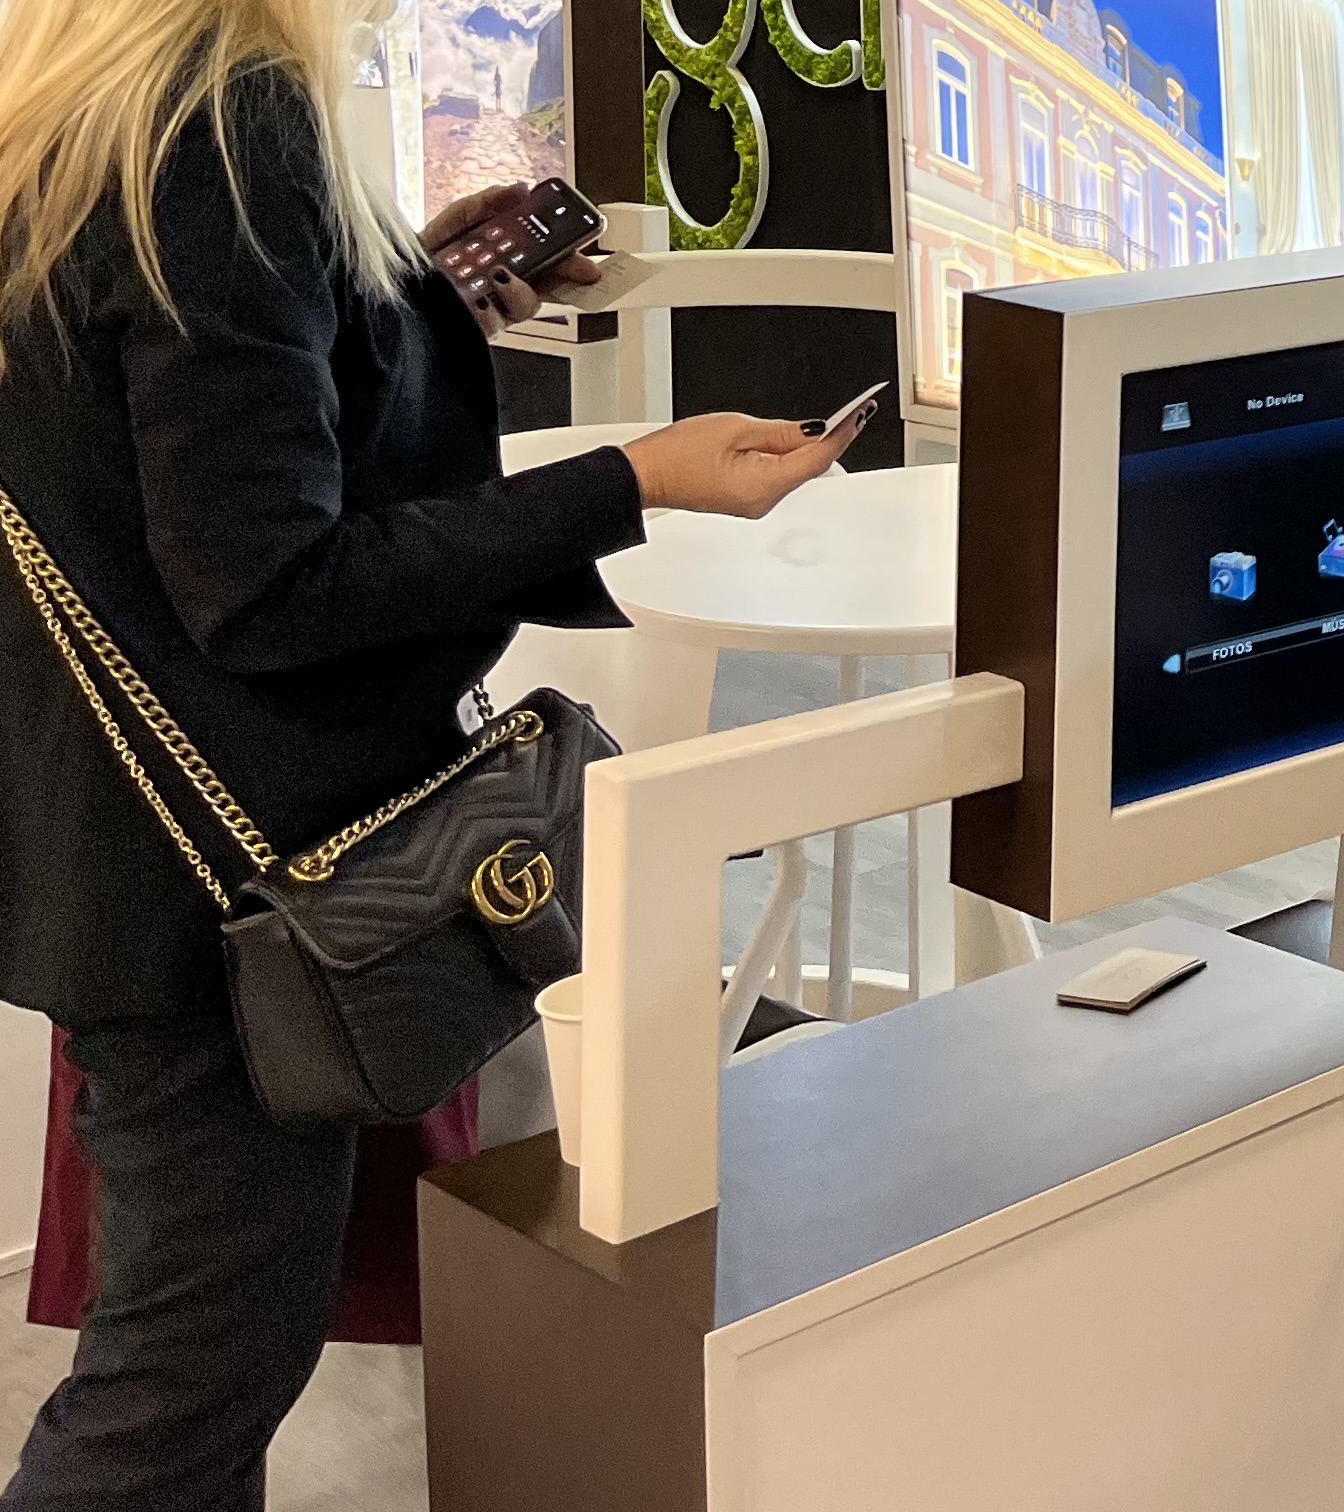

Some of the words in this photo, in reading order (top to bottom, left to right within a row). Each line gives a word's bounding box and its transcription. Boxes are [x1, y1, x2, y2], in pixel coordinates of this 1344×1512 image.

[1247, 398, 1263, 411] No
[1266, 392, 1305, 408] Device
[1212, 640, 1253, 661] FOTOS
